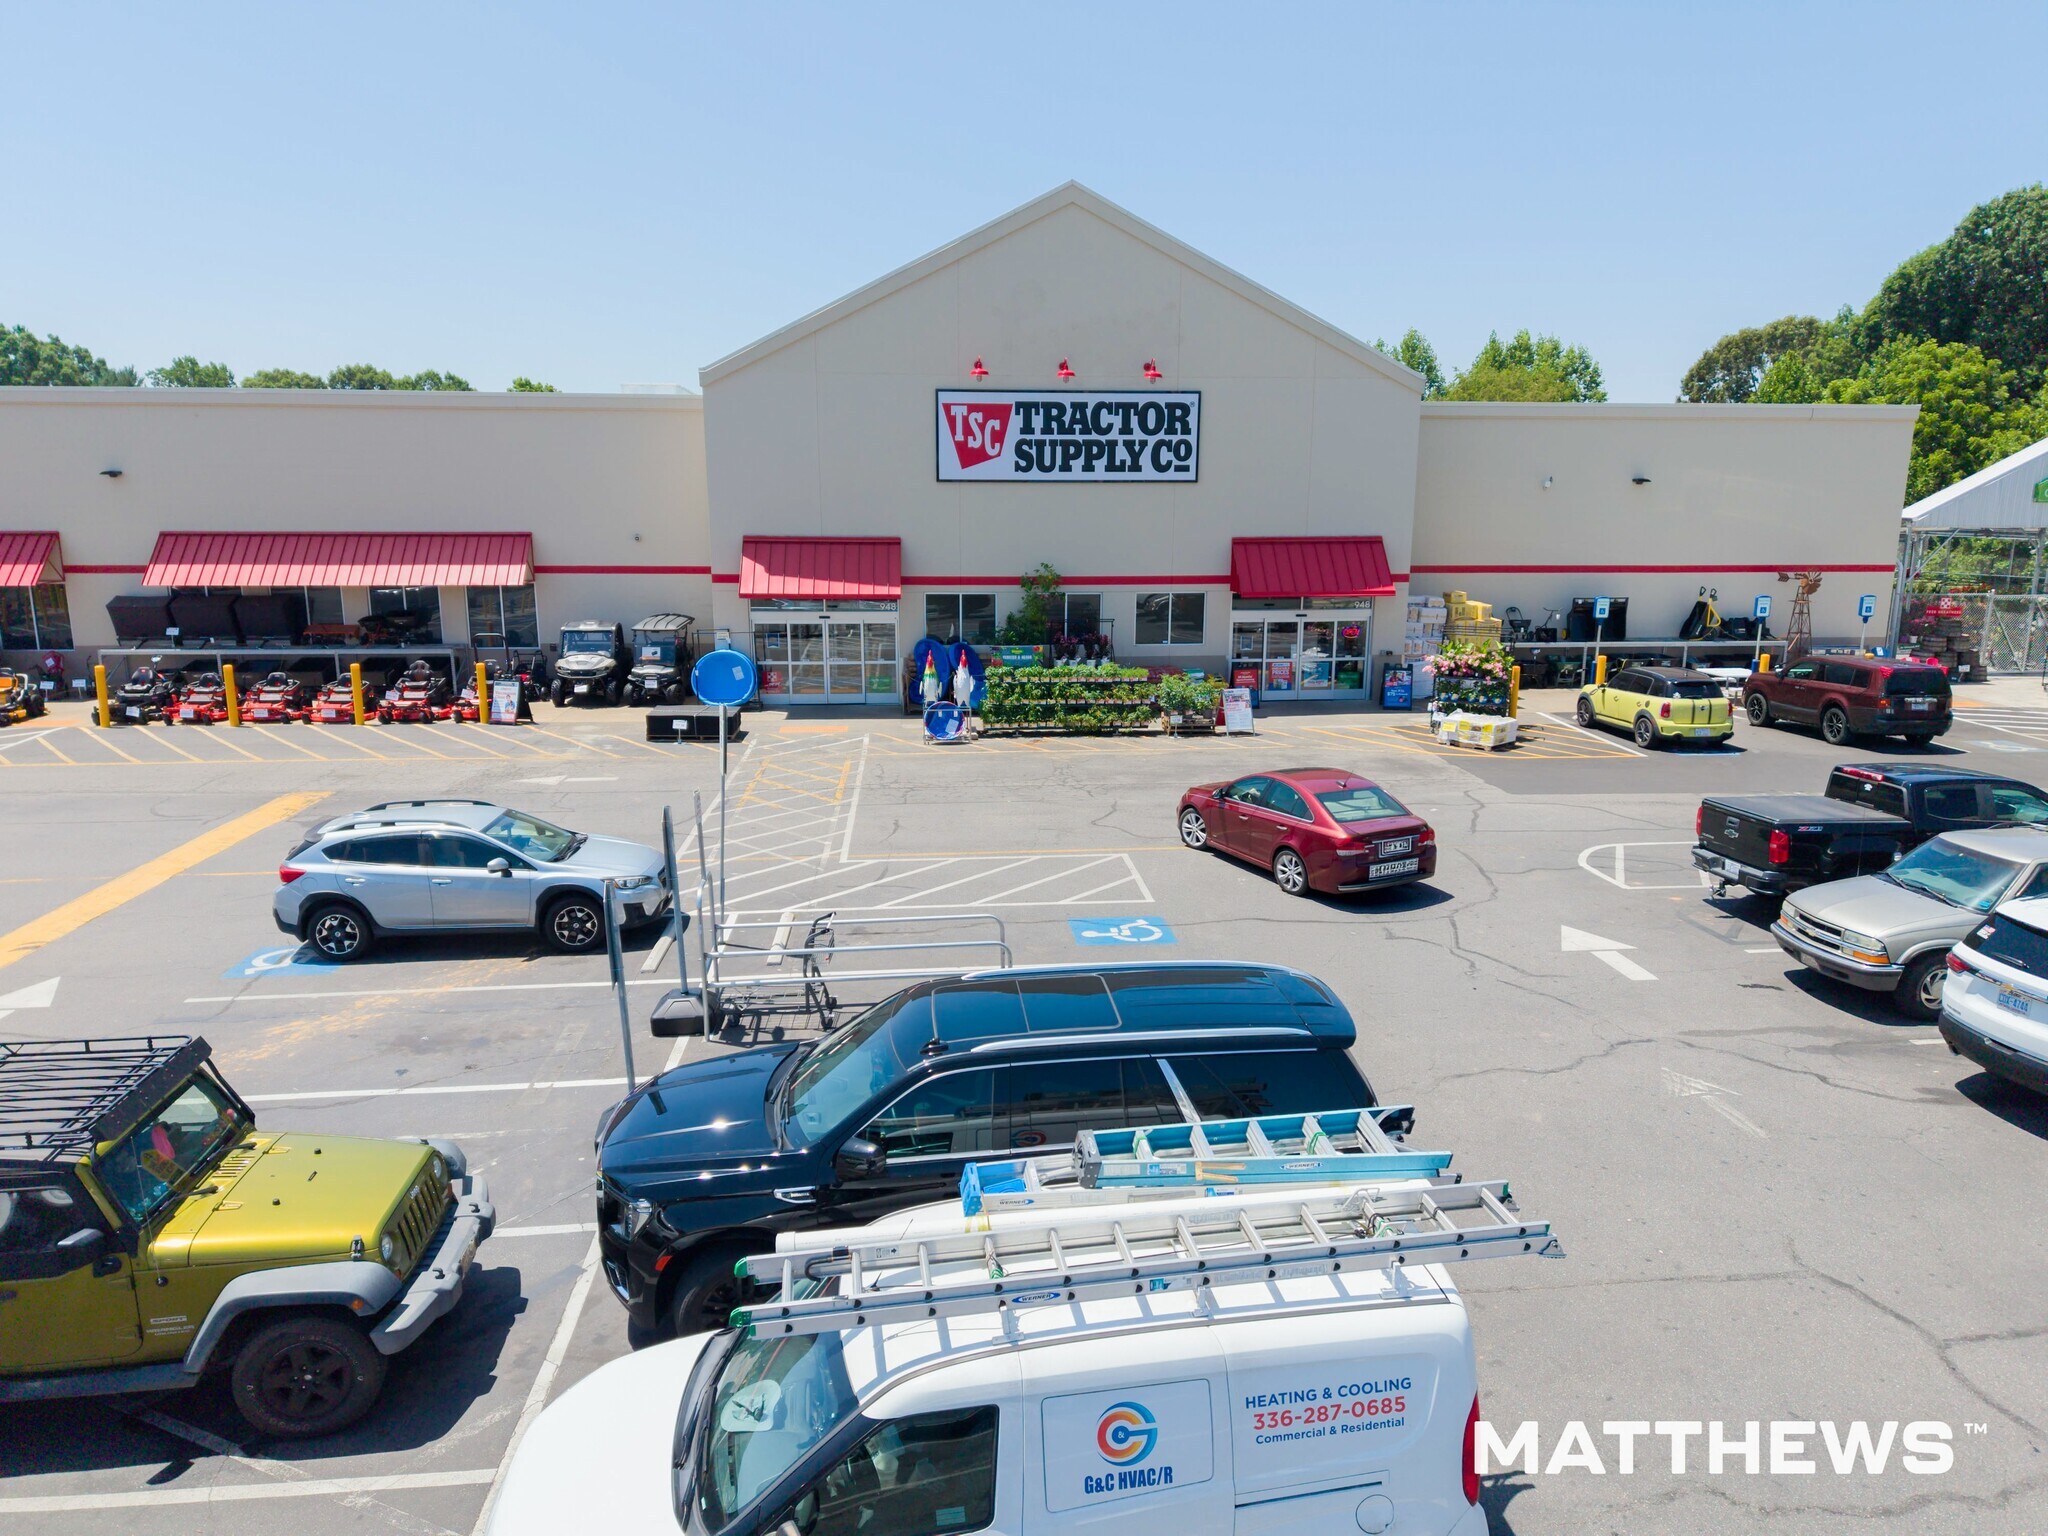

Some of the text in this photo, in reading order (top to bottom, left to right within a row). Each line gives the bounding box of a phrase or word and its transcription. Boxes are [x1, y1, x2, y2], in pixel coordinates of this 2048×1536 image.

[950, 405, 1000, 456] TSC
[1014, 401, 1192, 436] TRACTOR
[1014, 438, 1148, 473] SUPPLY
[880, 602, 897, 611] 948
[1354, 601, 1371, 609] 948
[1021, 1293, 1051, 1303] WERNER
[1245, 1377, 1412, 1409] HEATING & COOLING
[1253, 1396, 1407, 1431] 336-287-0685
[1255, 1417, 1405, 1445] Commercial & Residential
[1084, 1466, 1173, 1494] G&C HVAC/R
